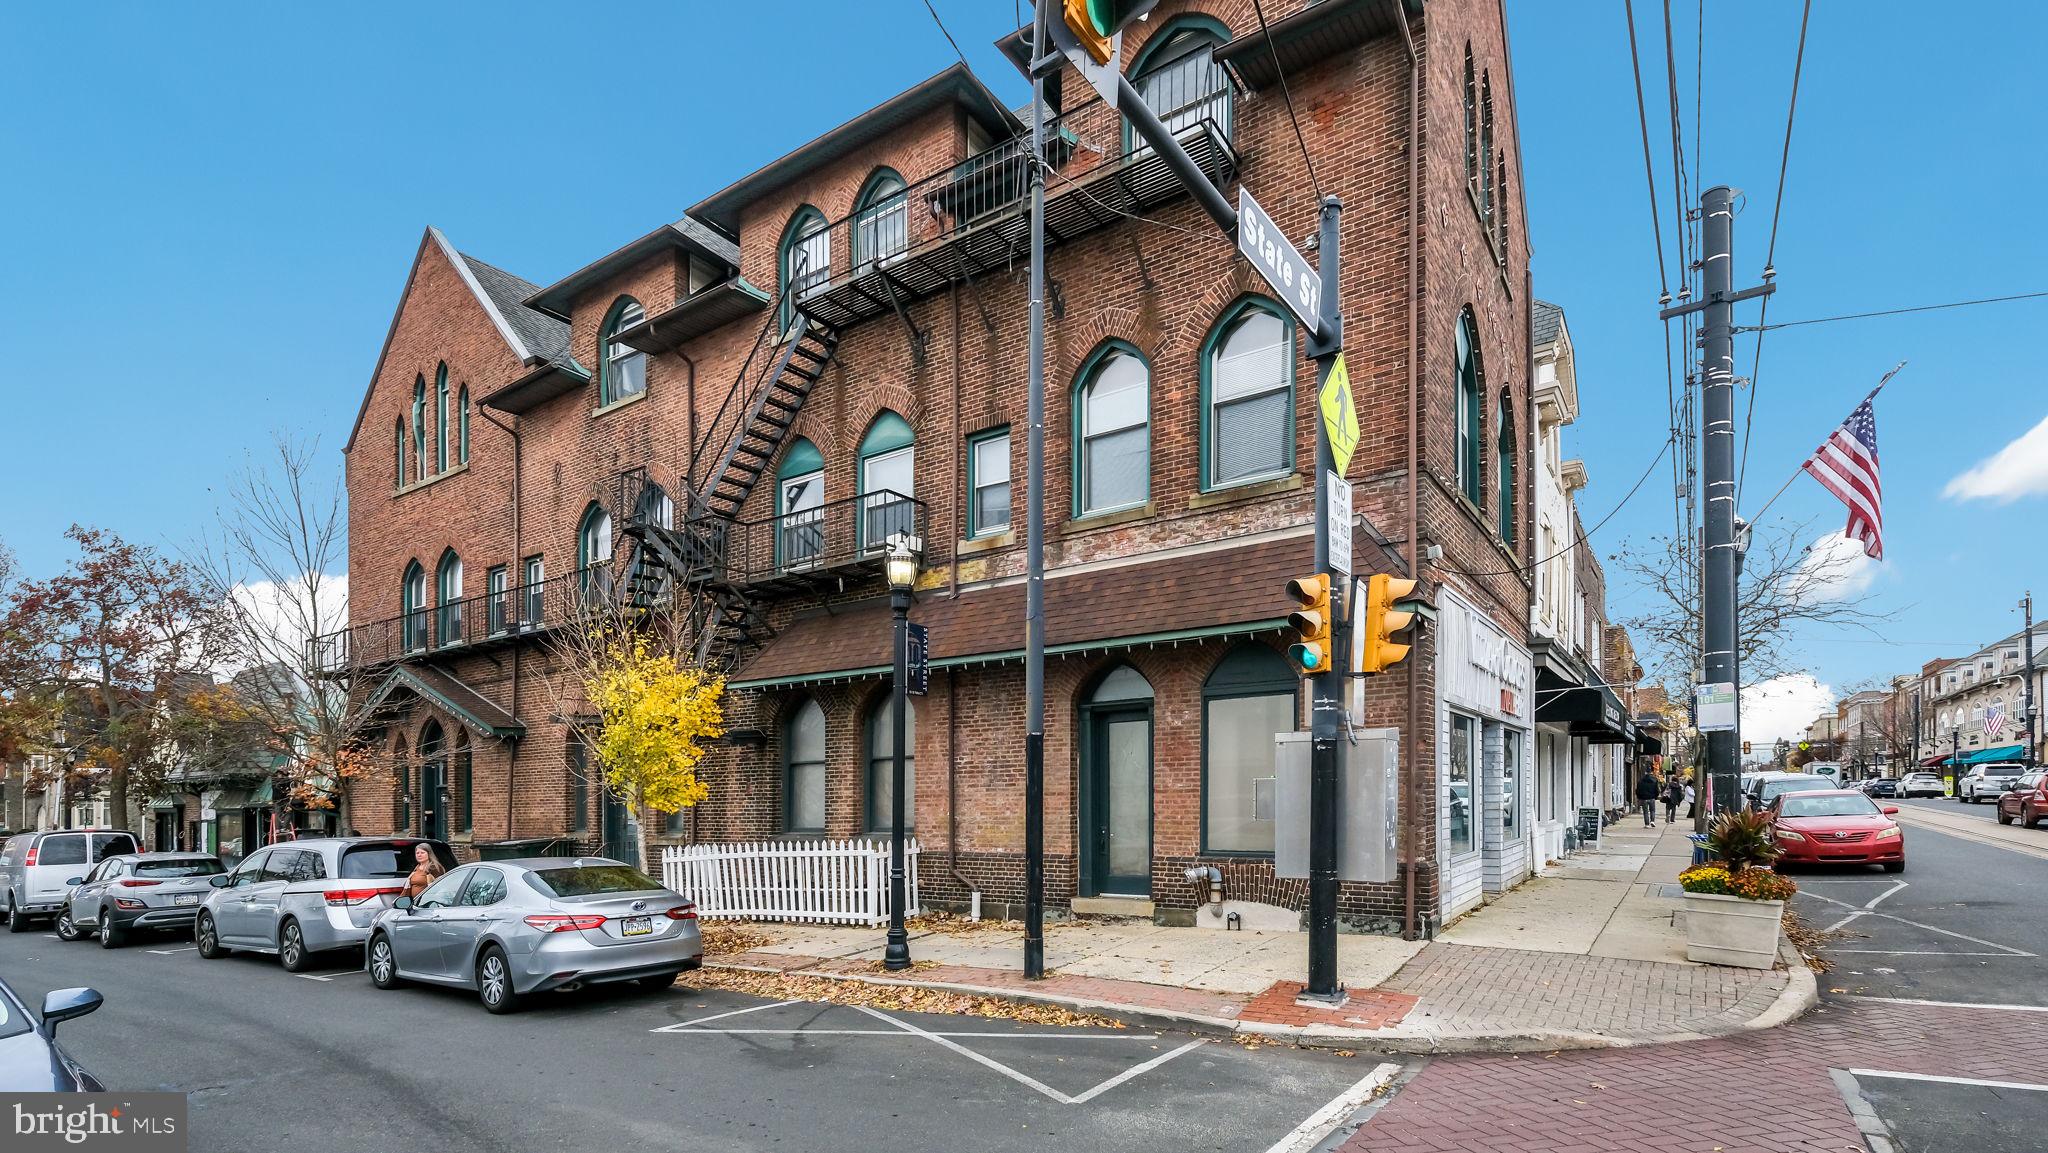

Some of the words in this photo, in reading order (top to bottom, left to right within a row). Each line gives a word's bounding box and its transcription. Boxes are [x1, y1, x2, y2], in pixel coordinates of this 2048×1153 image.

[1244, 207, 1293, 288] State
[1299, 272, 1317, 316] St
[1334, 481, 1346, 501] NO
[1333, 500, 1348, 520] TURN
[1331, 517, 1339, 533] ON
[1340, 523, 1350, 540] RED
[1698, 696, 1714, 704] 101
